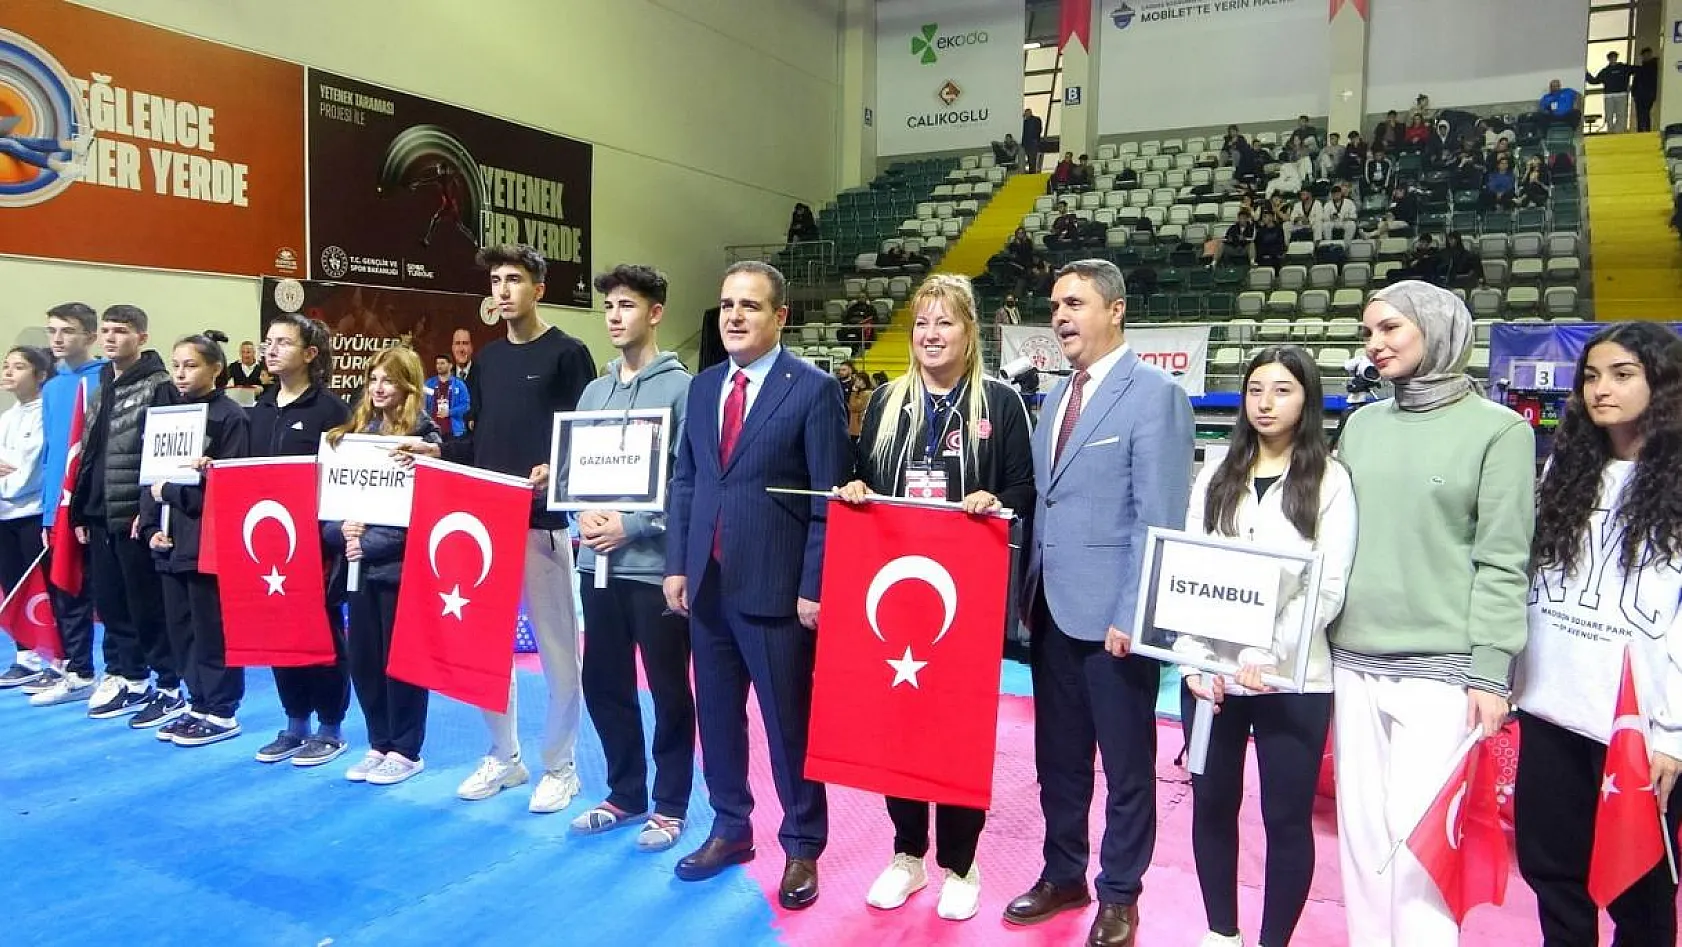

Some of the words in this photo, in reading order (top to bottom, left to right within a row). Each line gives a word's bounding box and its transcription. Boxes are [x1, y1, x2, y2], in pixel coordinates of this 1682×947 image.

[1069, 87, 1077, 99] B
[149, 147, 249, 207] YERDE
[480, 164, 564, 219] YETENEK
[480, 209, 519, 249] HER
[524, 217, 582, 263] YERDE
[329, 333, 401, 351] ÜYÜKLER
[331, 353, 372, 371] TÜRK
[1136, 352, 1187, 370] OTO
[1540, 371, 1550, 386] 3
[1524, 408, 1534, 420] 0
[328, 466, 406, 491] NEVŞEHİR
[1170, 575, 1265, 607] İSTANBUL
[1541, 606, 1570, 621] MADISON
[1571, 615, 1604, 632] SQUARE
[1605, 624, 1633, 638] PARK
[1567, 627, 1599, 641] AVENUE
